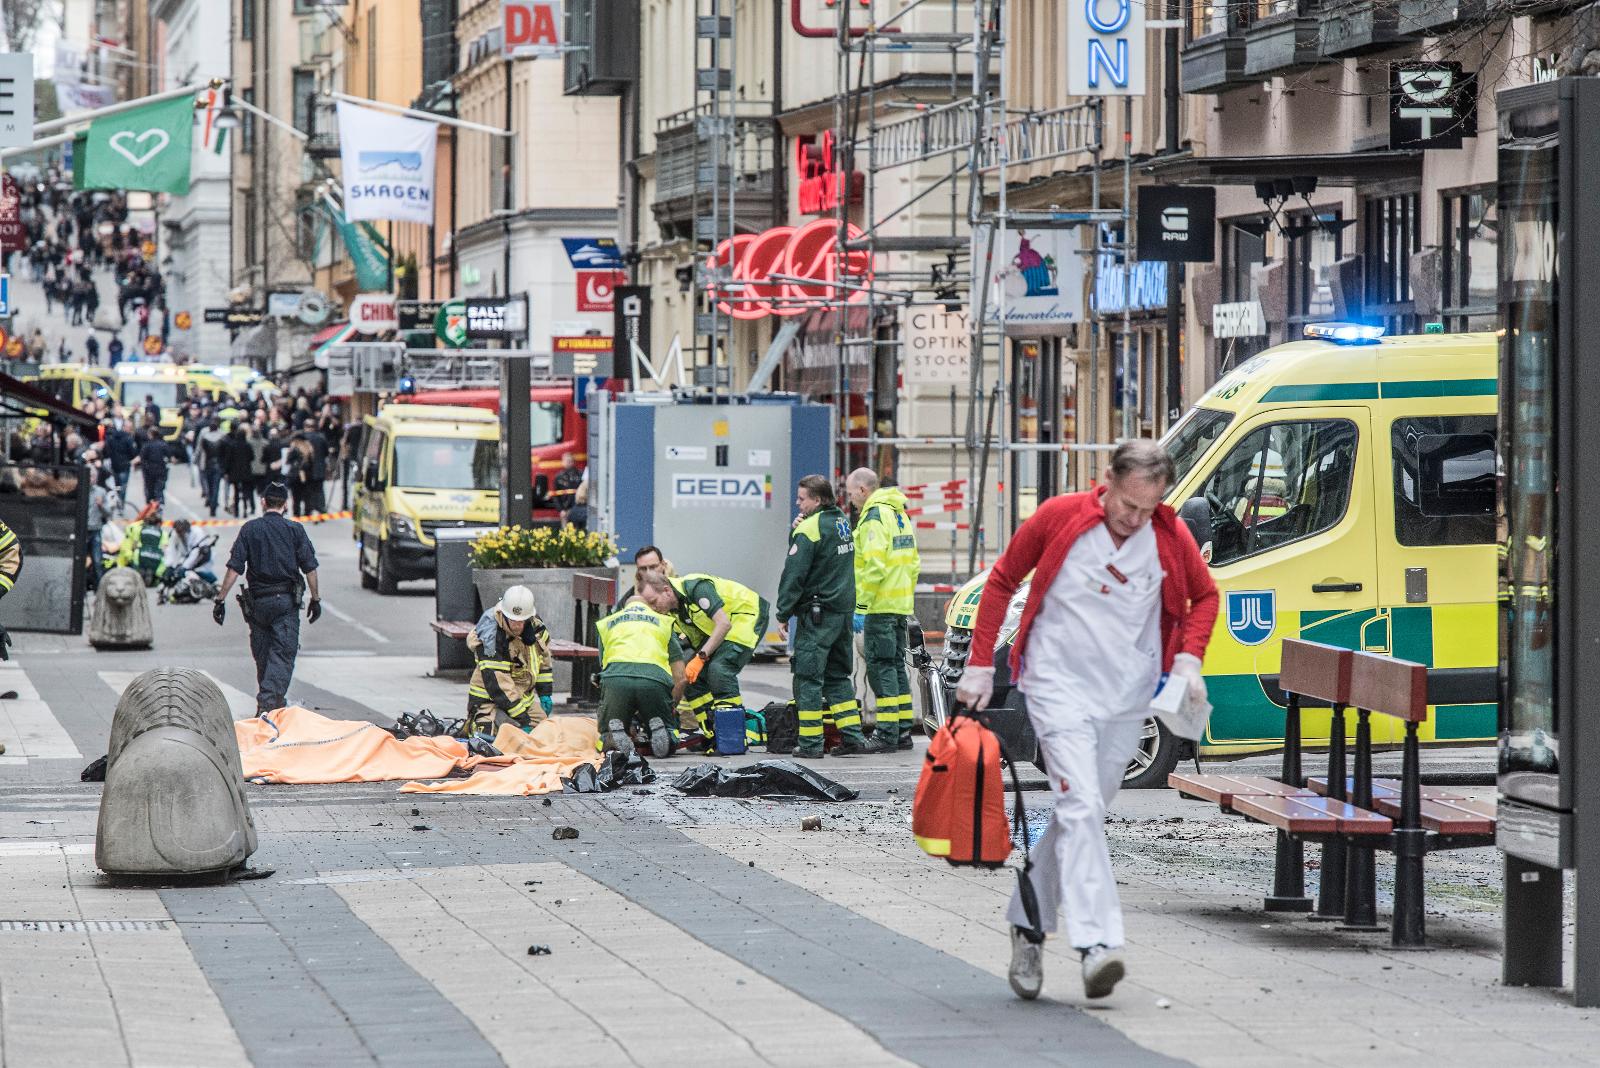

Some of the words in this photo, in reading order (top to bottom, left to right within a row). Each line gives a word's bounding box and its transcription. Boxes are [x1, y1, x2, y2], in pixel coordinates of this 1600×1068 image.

[505, 5, 558, 44] DA
[351, 184, 430, 201] SKAGEN
[1162, 231, 1189, 242] RAW
[912, 313, 969, 330] CITY
[913, 336, 968, 350] OPTIK
[914, 354, 968, 367] STOCK
[676, 479, 762, 495] GEDA
